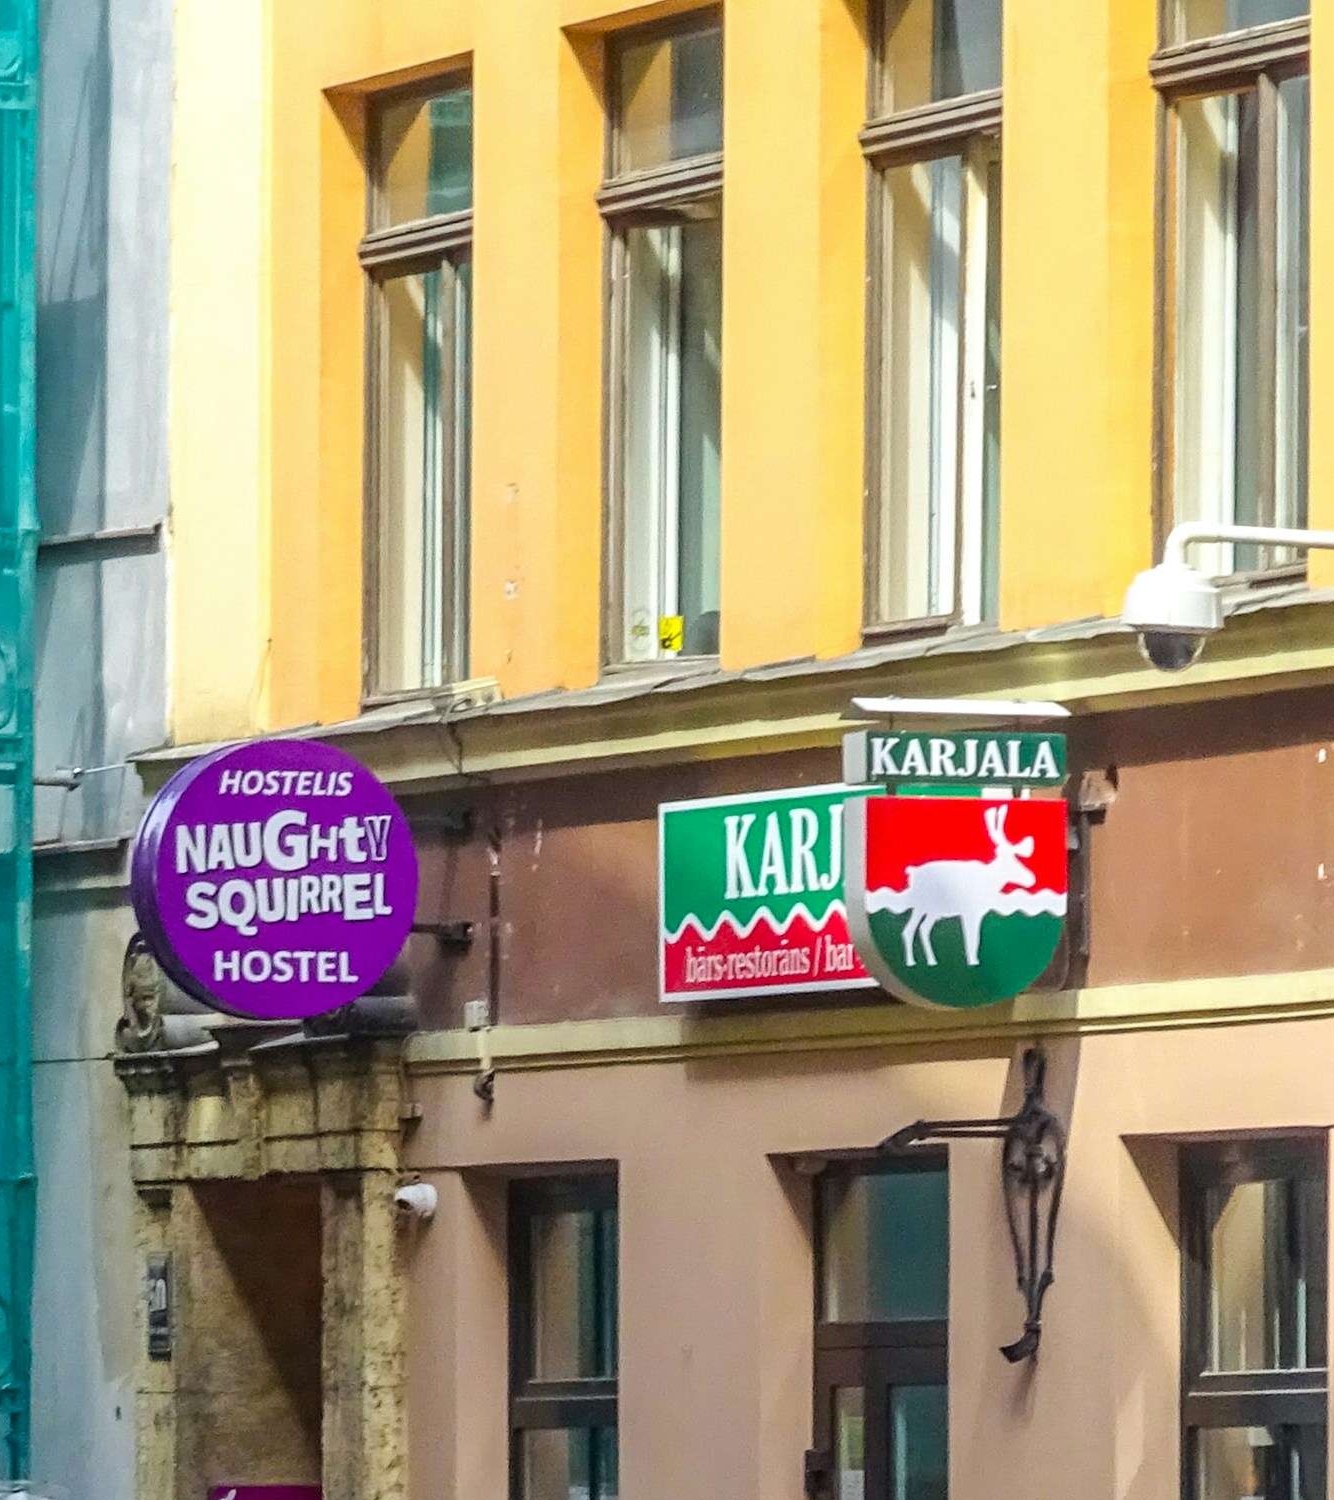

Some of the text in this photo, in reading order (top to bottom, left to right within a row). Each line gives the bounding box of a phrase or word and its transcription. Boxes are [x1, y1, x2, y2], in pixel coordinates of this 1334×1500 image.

[870, 737, 1060, 779] KARJALA
[219, 769, 354, 796] HOSTELIS
[184, 872, 394, 937] SQUIRREL
[213, 949, 360, 983] HOSTEL
